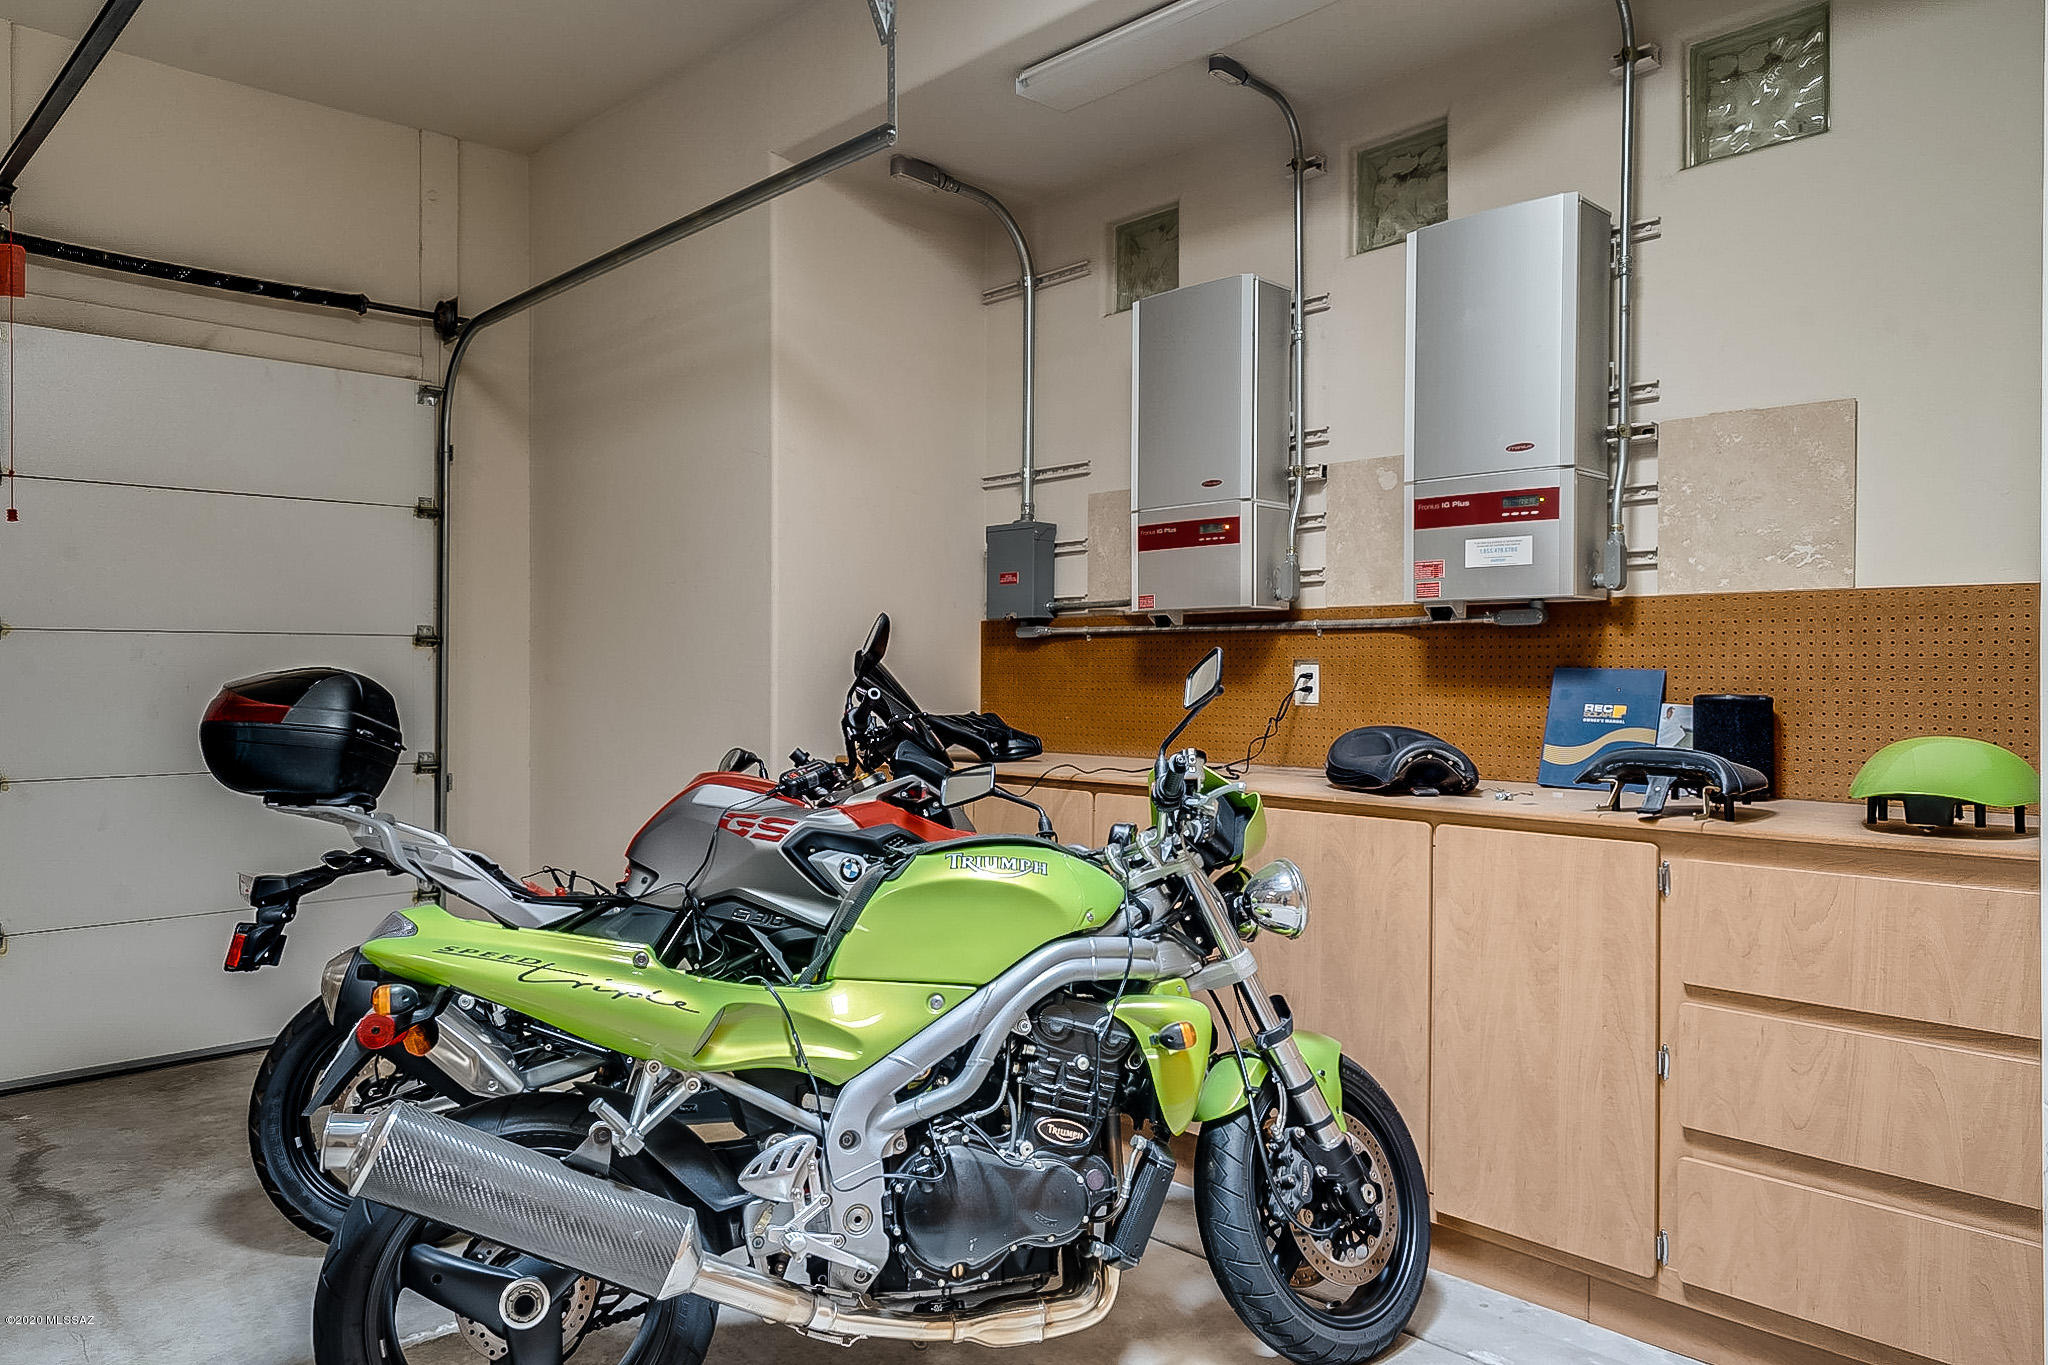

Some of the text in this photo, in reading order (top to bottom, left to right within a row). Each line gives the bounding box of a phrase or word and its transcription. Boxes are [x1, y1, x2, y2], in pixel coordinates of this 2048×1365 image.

[1451, 500, 1470, 508] Plus
[1584, 703, 1614, 713] REC
[718, 811, 799, 843] GS
[945, 852, 1048, 877] TRIUMPH
[437, 945, 543, 967] SPEED
[1047, 1123, 1084, 1141] TRIUMPH
